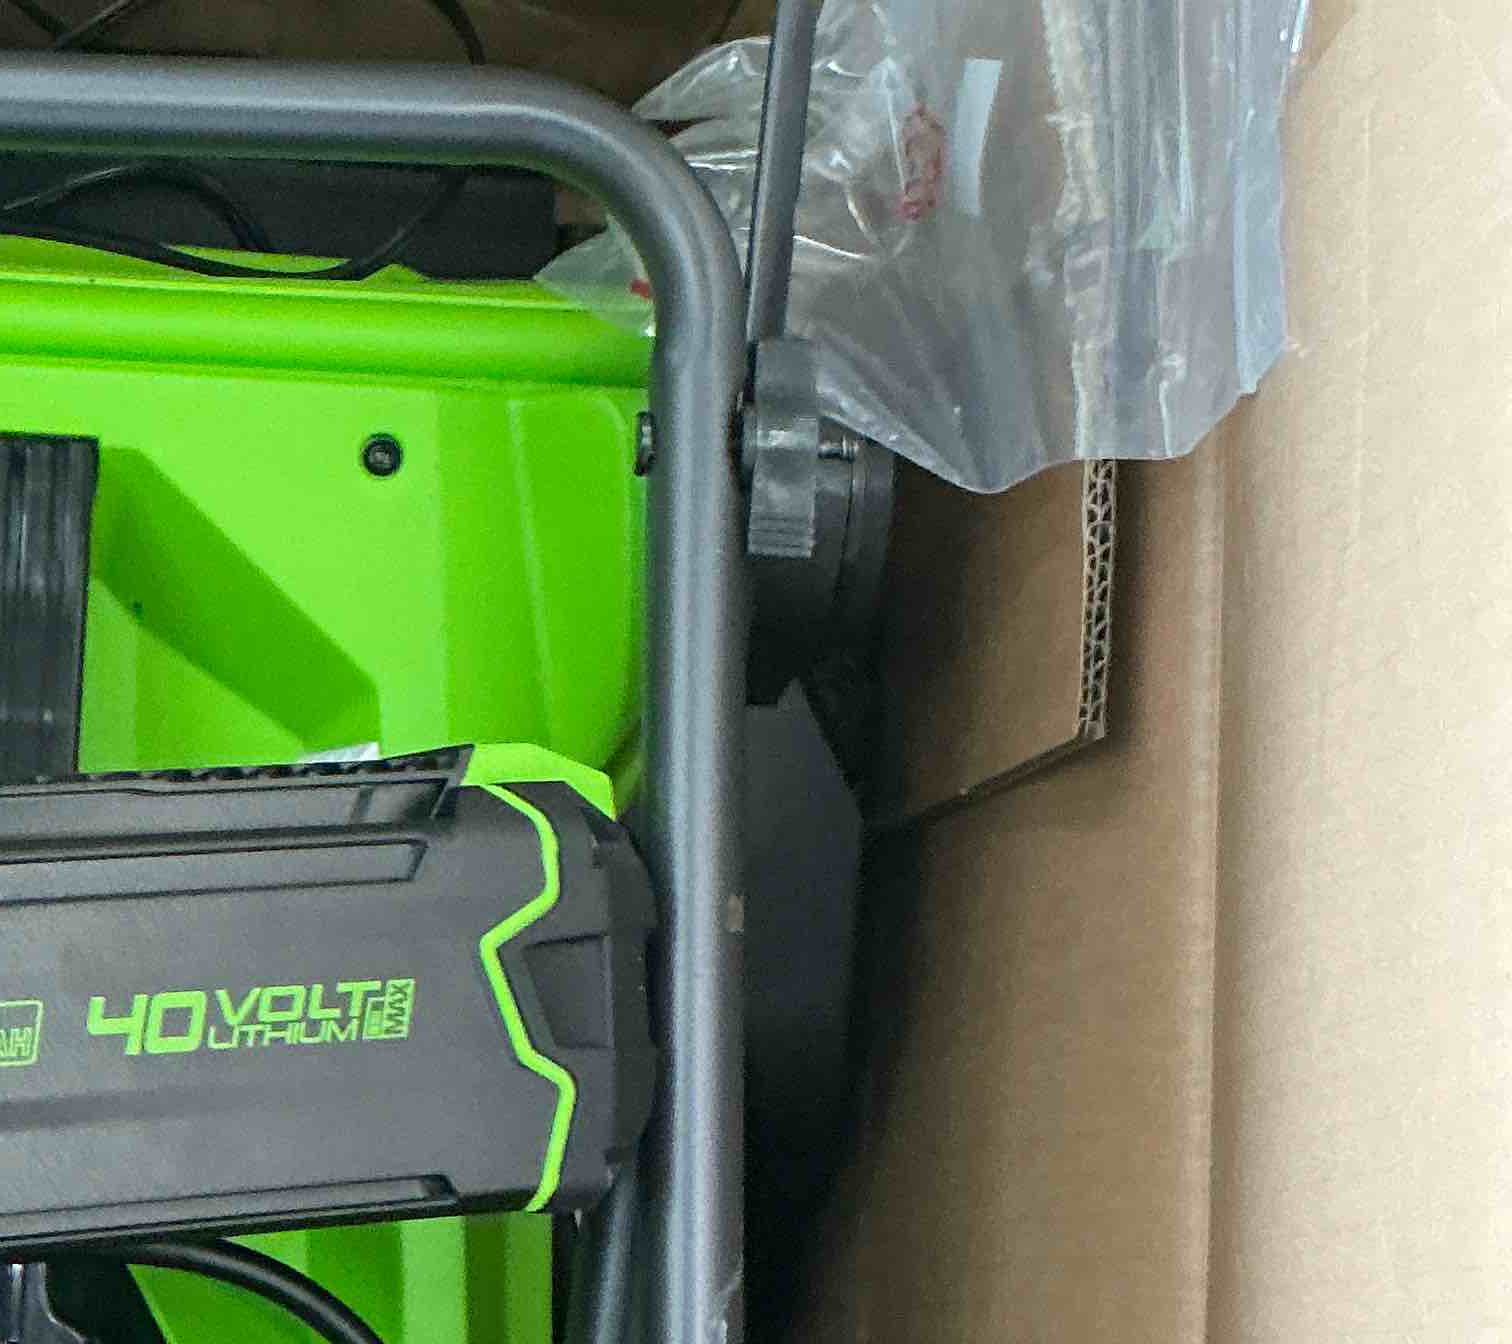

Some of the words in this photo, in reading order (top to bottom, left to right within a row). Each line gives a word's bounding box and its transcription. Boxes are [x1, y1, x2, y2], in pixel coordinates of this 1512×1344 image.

[87, 990, 208, 1055] 40
[214, 979, 382, 1024] VOLT
[207, 1018, 361, 1050] LITHIUM
[386, 982, 410, 1035] MAX
